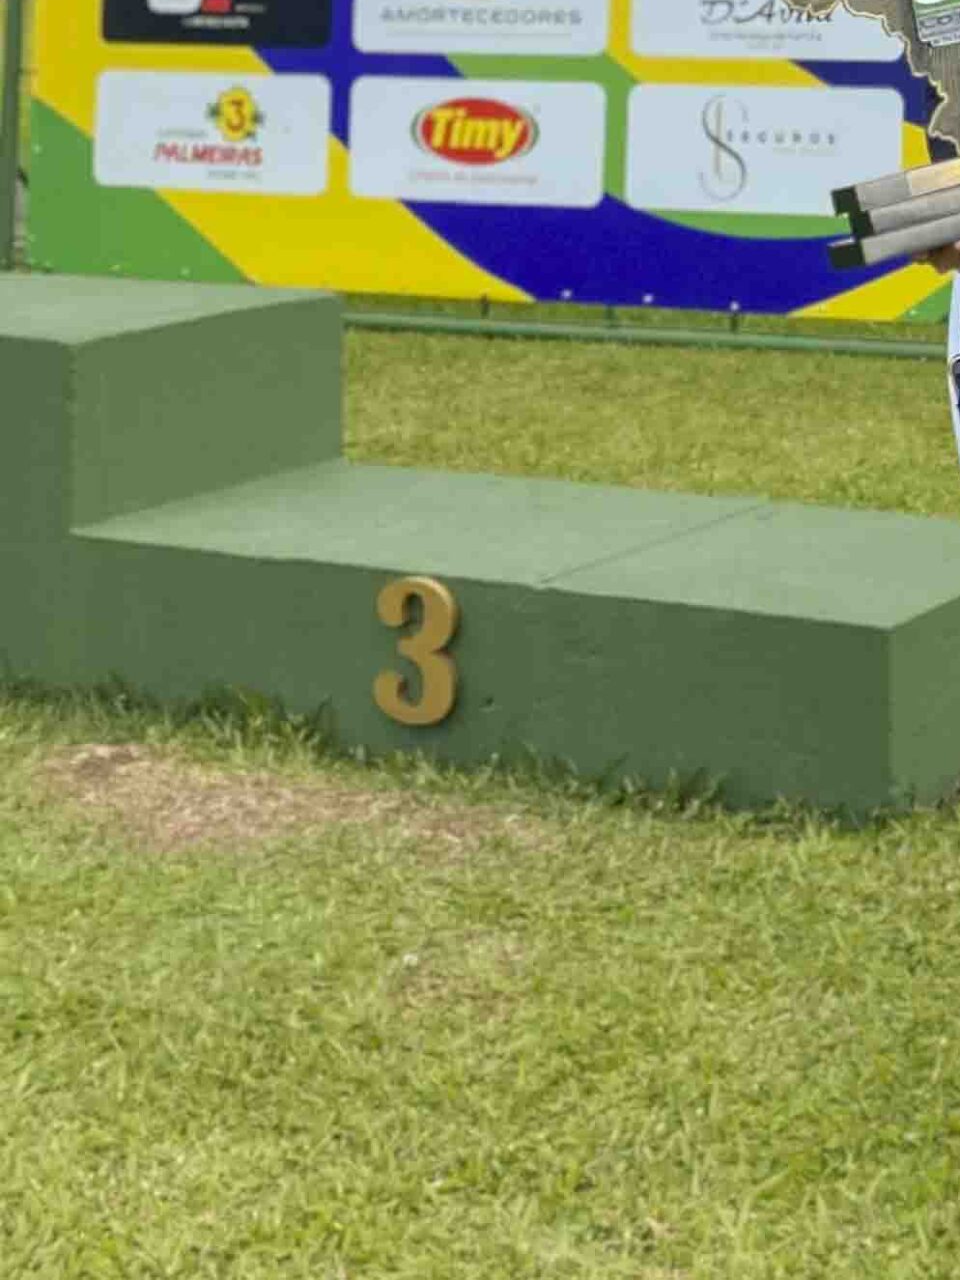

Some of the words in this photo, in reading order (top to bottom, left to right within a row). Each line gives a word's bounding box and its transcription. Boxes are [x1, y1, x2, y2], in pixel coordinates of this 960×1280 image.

[379, 4, 586, 26] AMORTECEDORES
[225, 97, 249, 133] 3
[431, 107, 525, 160] Timy
[153, 141, 264, 167] PALMEIRAS
[373, 575, 458, 727] 3
